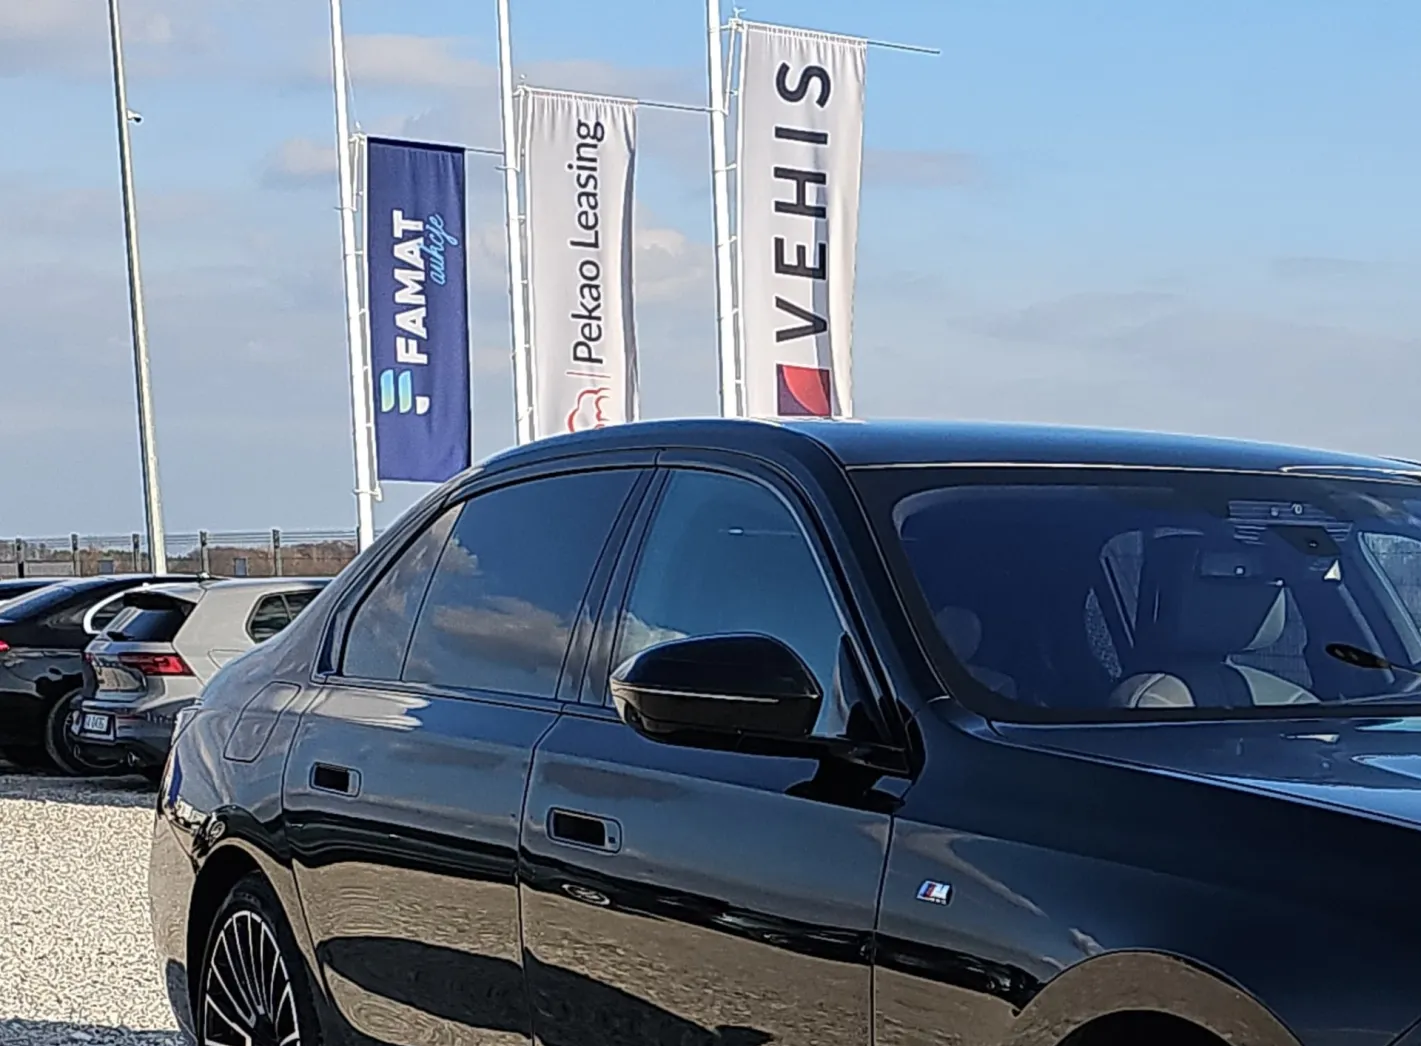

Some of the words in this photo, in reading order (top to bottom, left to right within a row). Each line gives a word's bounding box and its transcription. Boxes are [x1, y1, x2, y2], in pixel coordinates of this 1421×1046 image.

[567, 119, 605, 249] Leasing
[774, 62, 831, 343] VEHIS
[392, 209, 428, 365] FAMAT
[570, 260, 604, 364] Pekao
